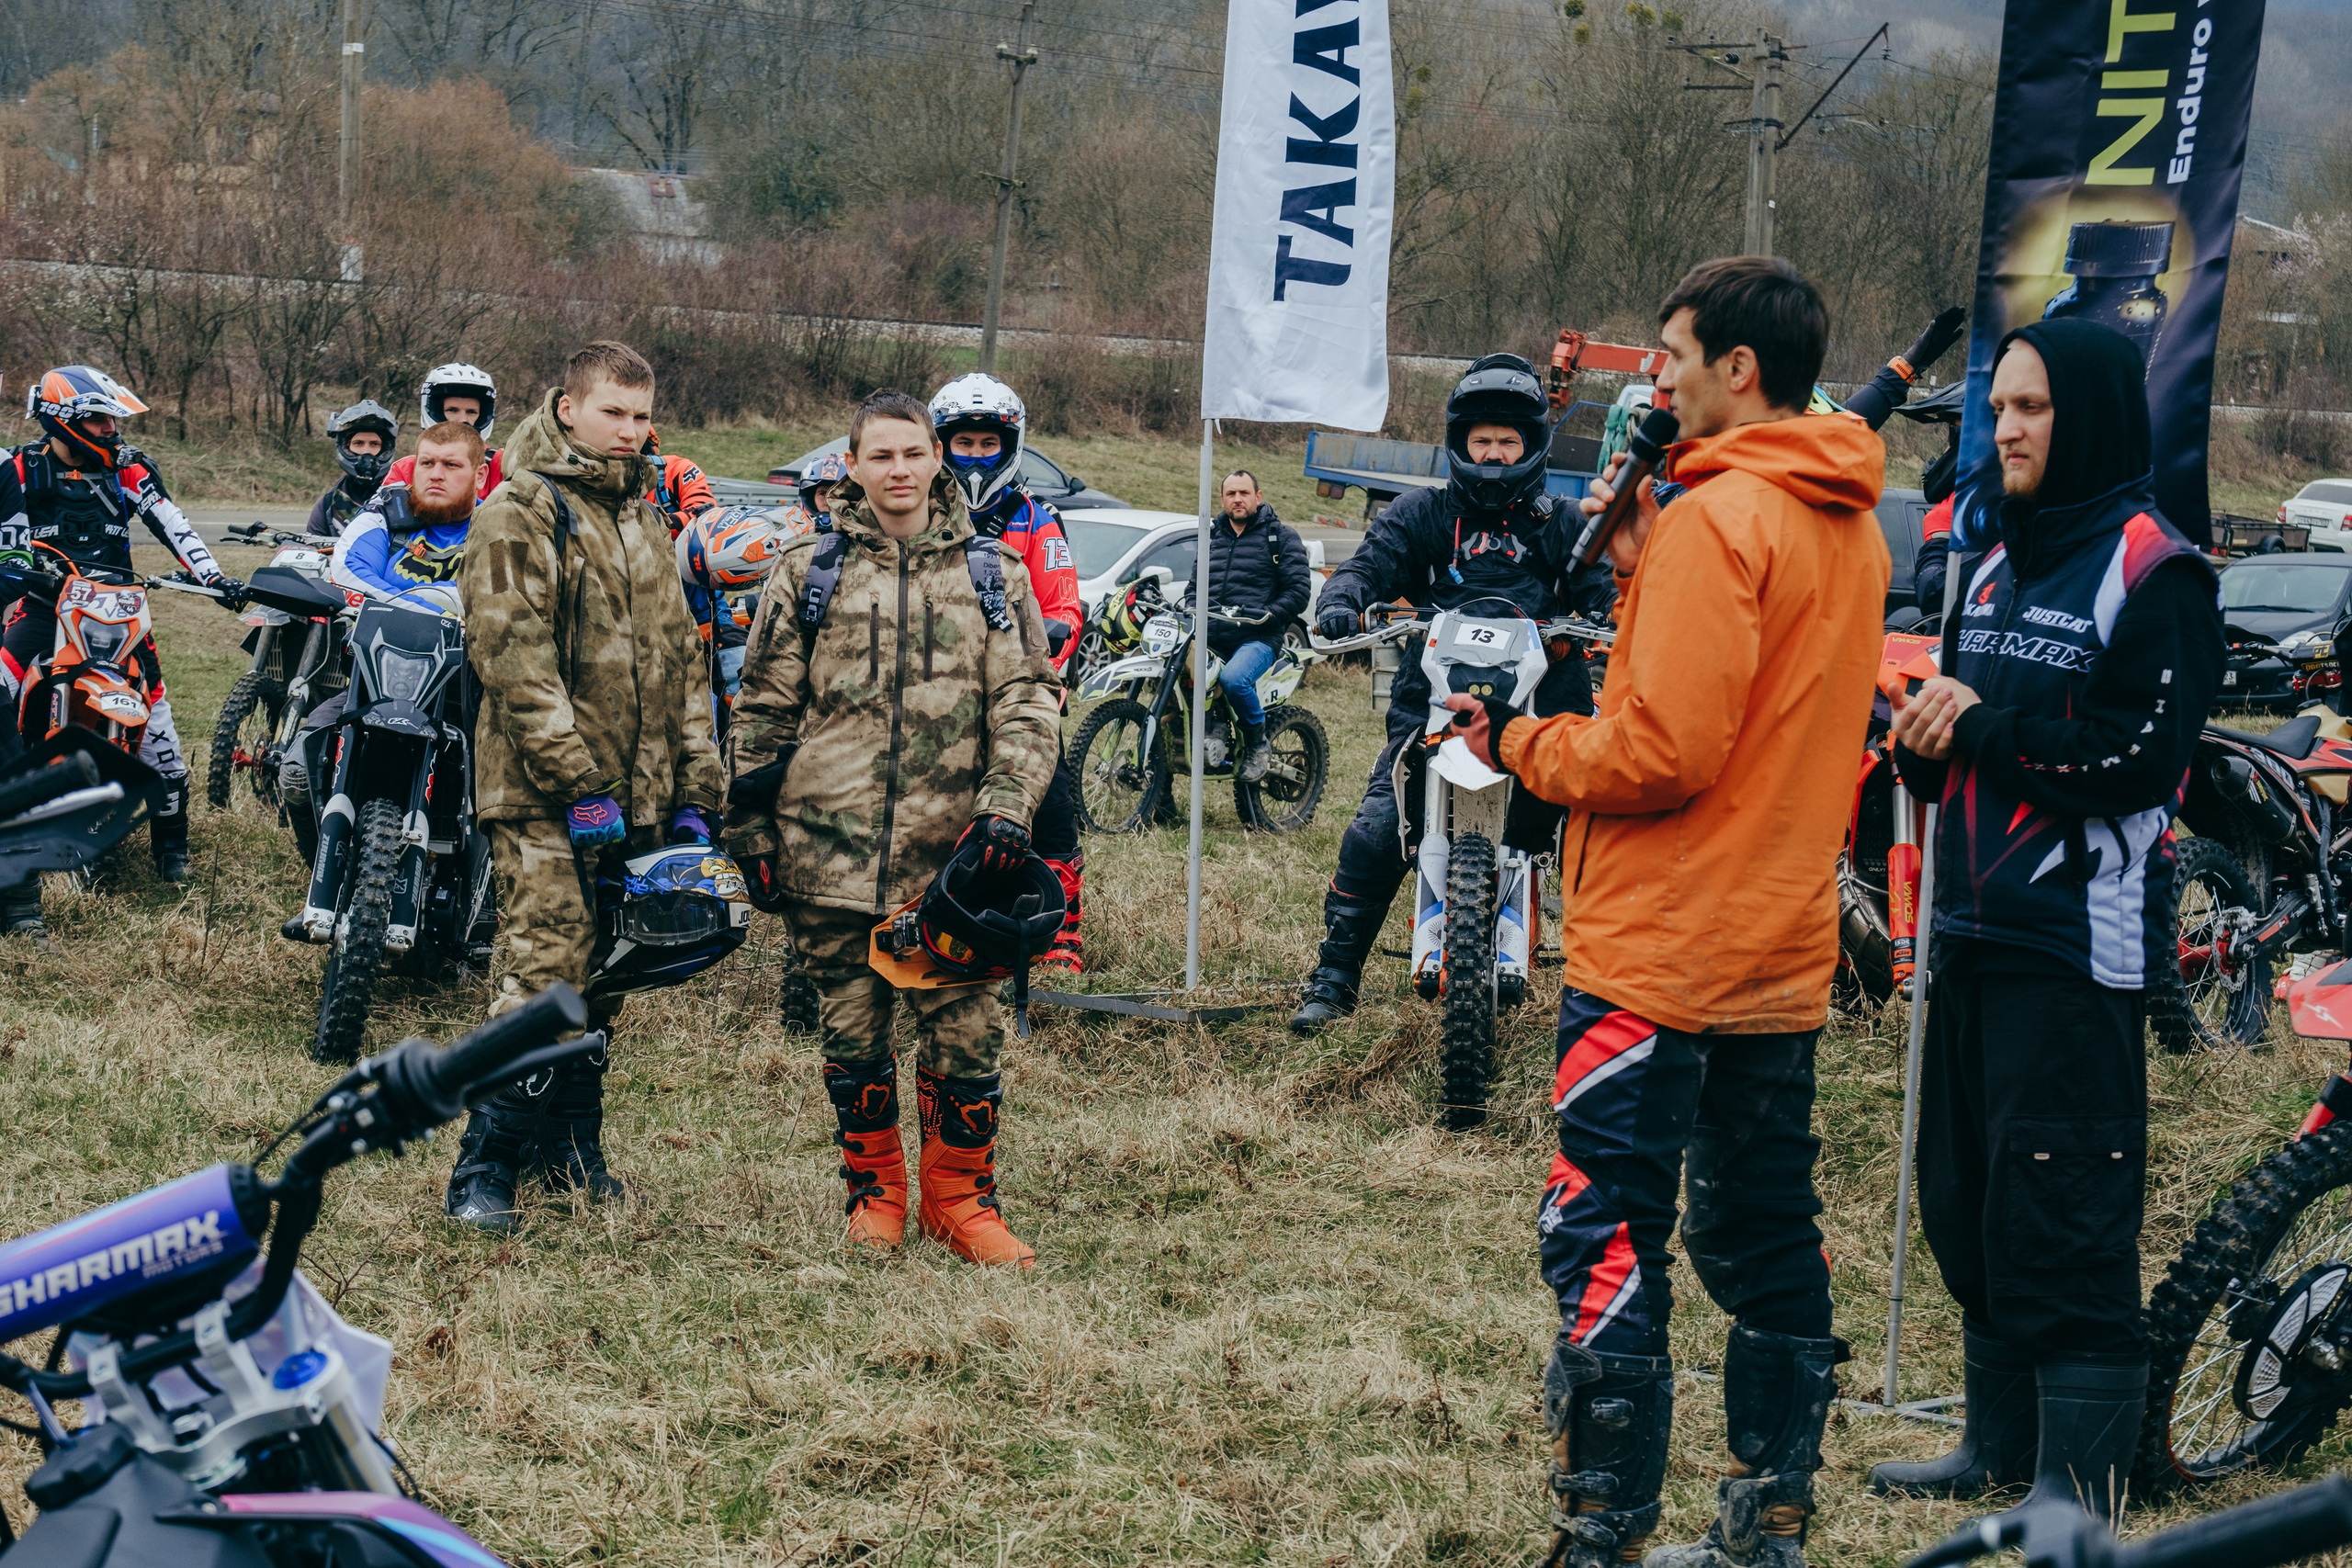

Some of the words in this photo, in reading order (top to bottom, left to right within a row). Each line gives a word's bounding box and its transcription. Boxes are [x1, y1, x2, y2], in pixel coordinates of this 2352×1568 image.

[2167, 17, 2212, 184] Enduro
[1273, 0, 1360, 301] TAKA
[40, 401, 93, 421] 100%
[1043, 536, 1073, 571] 13
[71, 587, 92, 601] 57
[1154, 628, 1171, 638] 150
[1471, 628, 1495, 643] 13
[112, 696, 138, 708] 161
[1271, 689, 1278, 703] R
[316, 833, 331, 884] ZUUMAV
[1904, 881, 1914, 924] VAMOS
